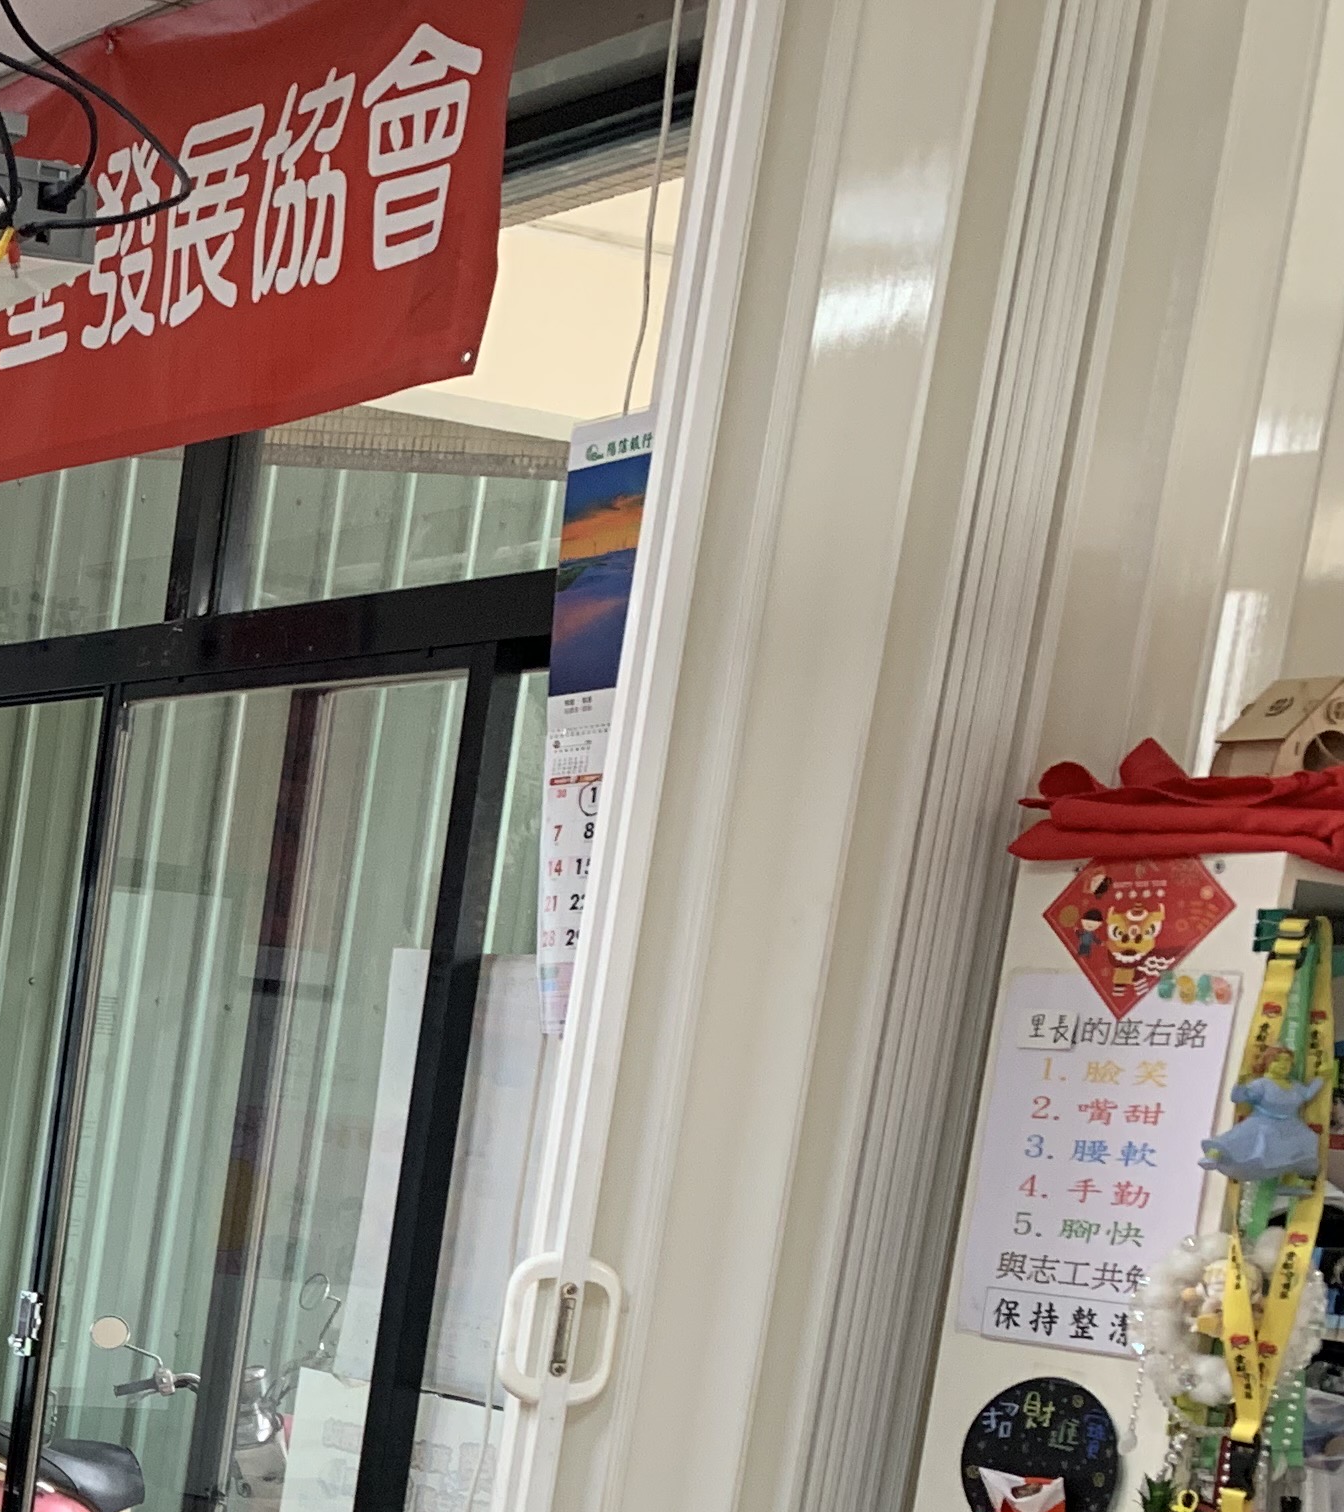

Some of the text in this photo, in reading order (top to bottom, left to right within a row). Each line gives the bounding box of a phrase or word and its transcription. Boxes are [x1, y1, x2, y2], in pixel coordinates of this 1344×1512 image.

[590, 786, 598, 804] 1
[553, 822, 595, 842] 7 8
[547, 859, 563, 877] 14
[1028, 1013, 1209, 1050] 里長的座右銘
[1083, 1059, 1169, 1088] 臉笑
[1078, 1097, 1166, 1127] 嘴甜
[1069, 1139, 1158, 1168] 腰軟
[1066, 1177, 1152, 1210] 手勤
[1058, 1217, 1146, 1249] 腳快
[983, 1390, 1110, 1461] 招財進寶
